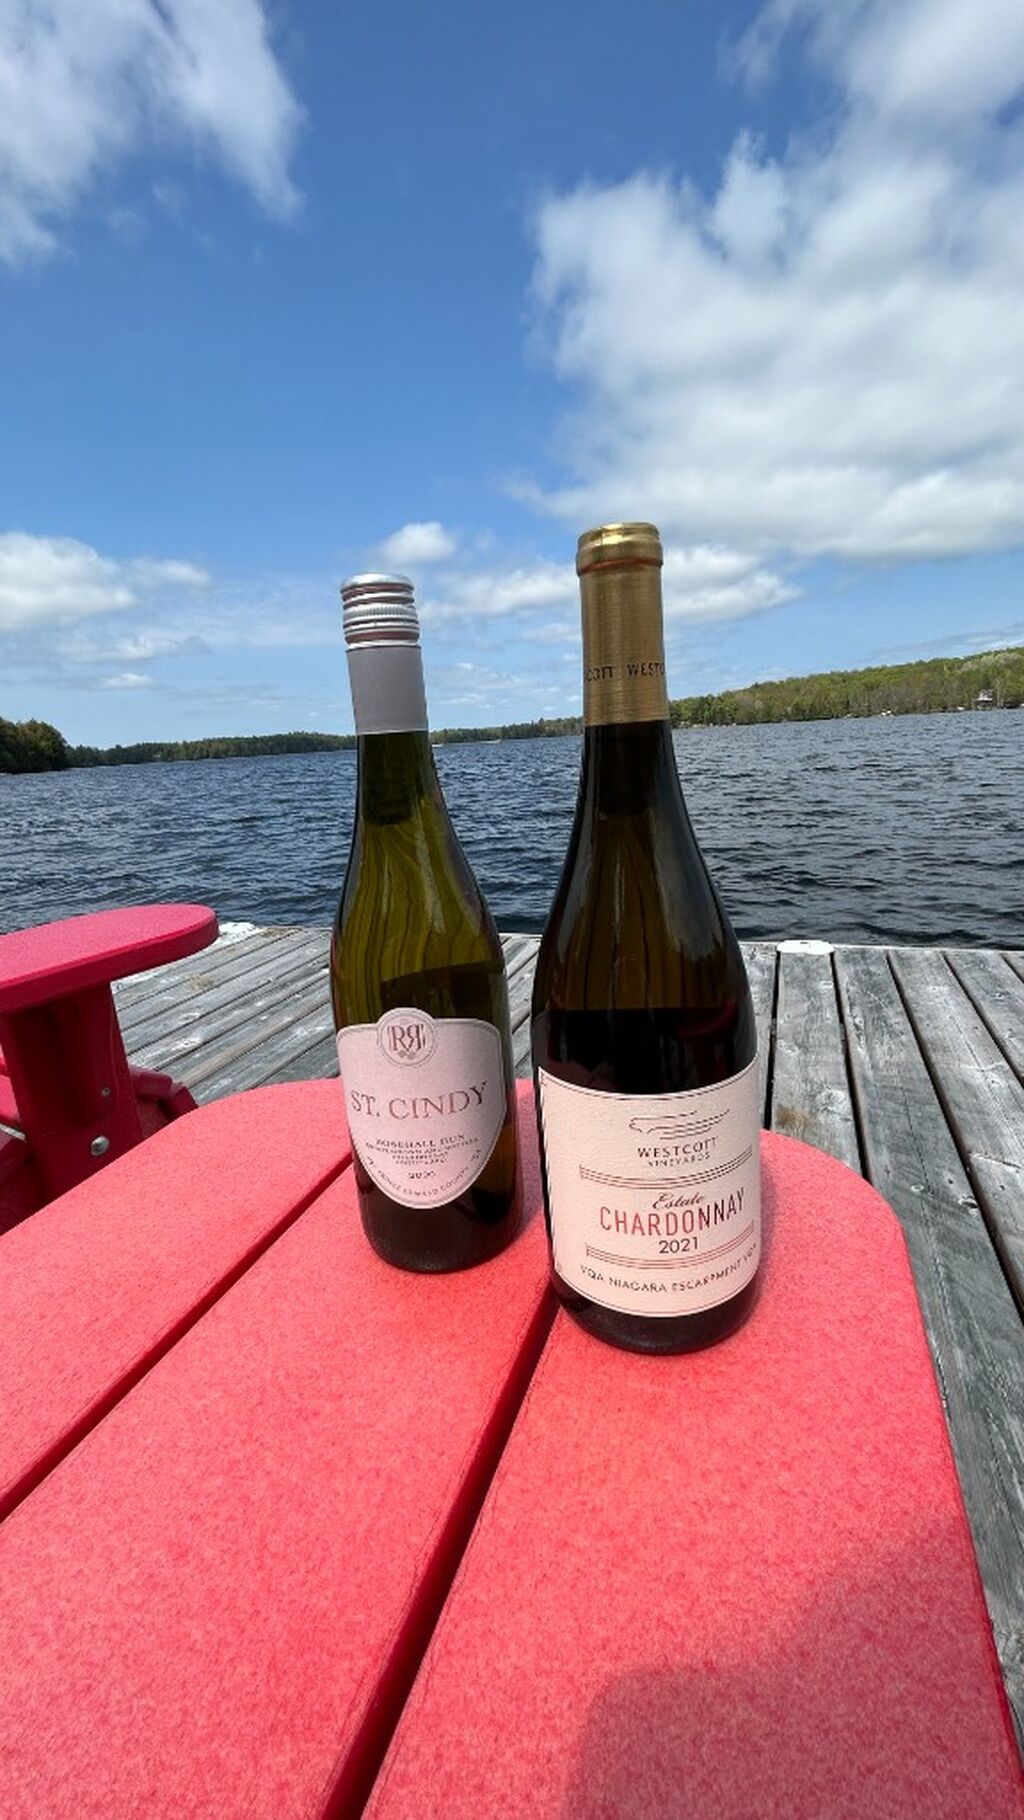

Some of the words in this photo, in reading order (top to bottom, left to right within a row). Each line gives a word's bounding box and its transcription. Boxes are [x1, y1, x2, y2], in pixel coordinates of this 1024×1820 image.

[351, 1090, 380, 1117] ST.
[389, 1080, 488, 1119] CINDY
[637, 1135, 719, 1158] WESTCOTT
[648, 1152, 711, 1167] VINEYARDS
[599, 1187, 745, 1237] CHARDONNAY
[652, 1191, 706, 1211] Estate
[659, 1236, 699, 1255] 2021
[609, 1275, 668, 1293] NIAGARA
[672, 1259, 742, 1293] ESCARPMENT
